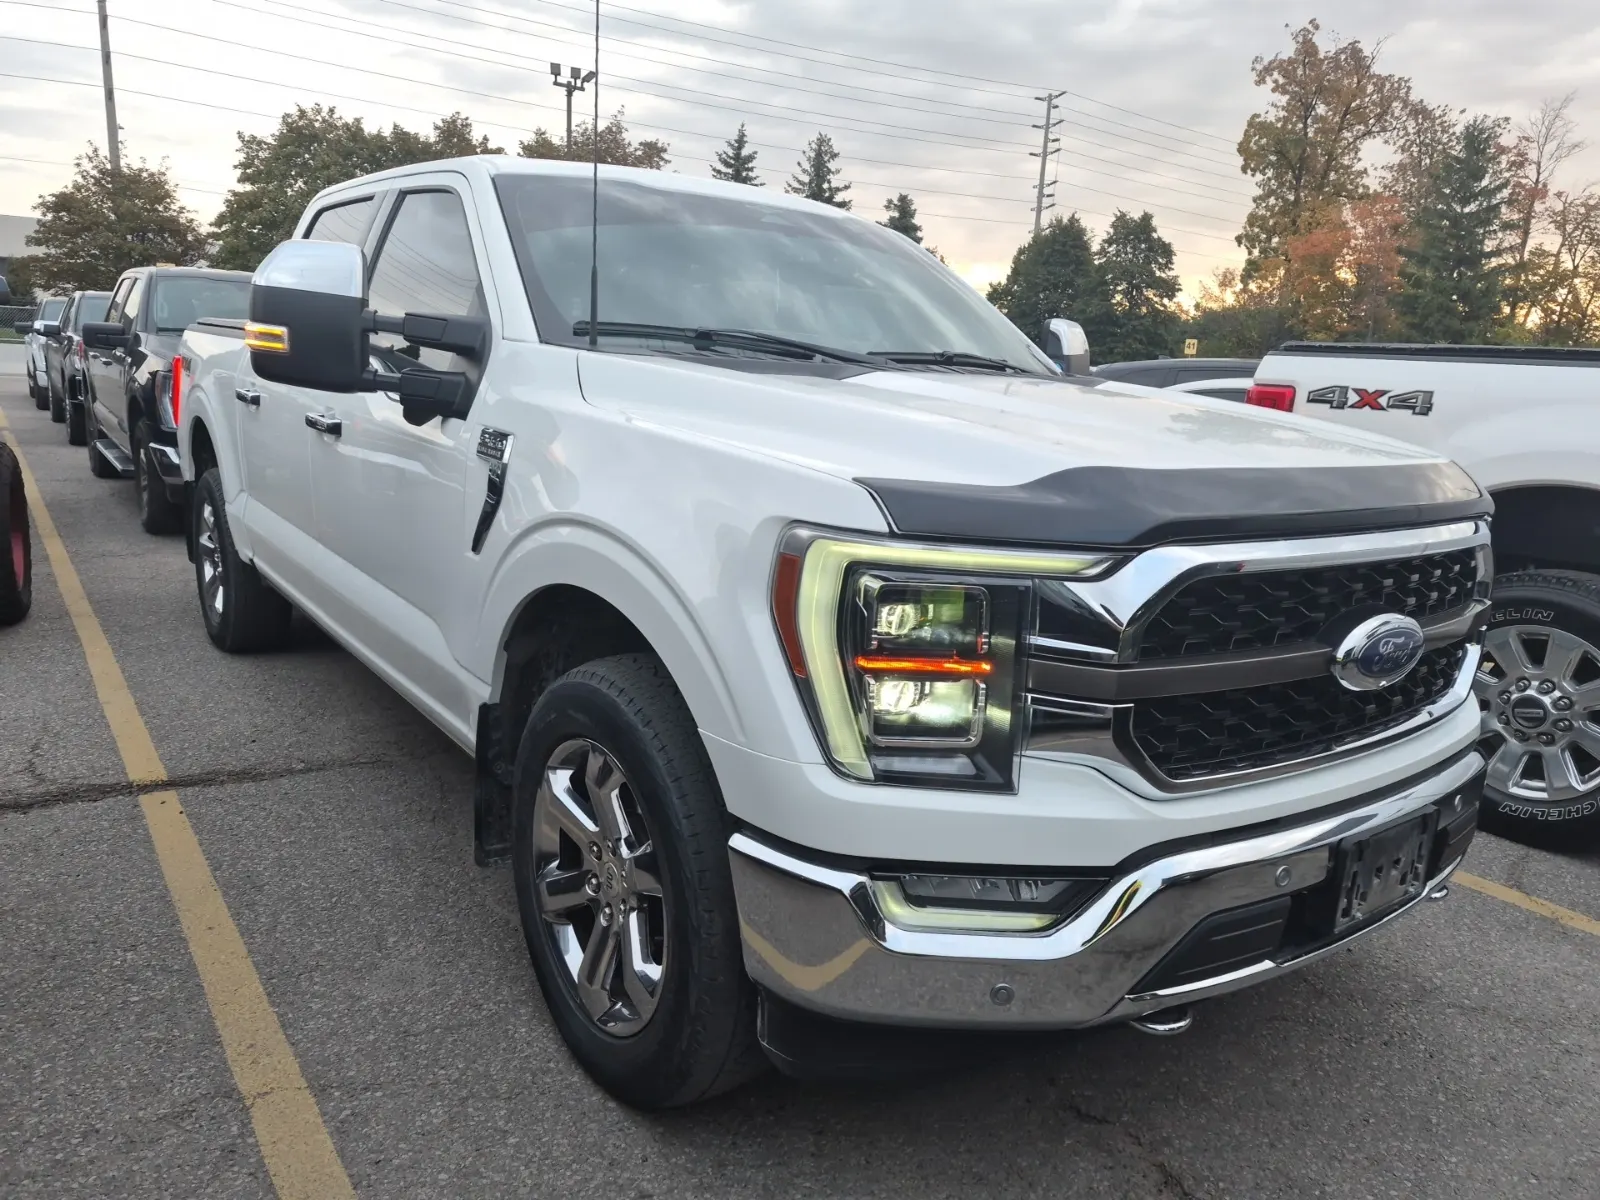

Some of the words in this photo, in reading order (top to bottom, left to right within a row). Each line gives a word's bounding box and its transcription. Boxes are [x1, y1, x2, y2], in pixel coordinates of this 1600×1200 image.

[1185, 341, 1196, 350] 41
[1491, 608, 1555, 622] ELIN
[1372, 636, 1414, 672] Ford
[1498, 797, 1600, 821] CHELIN
